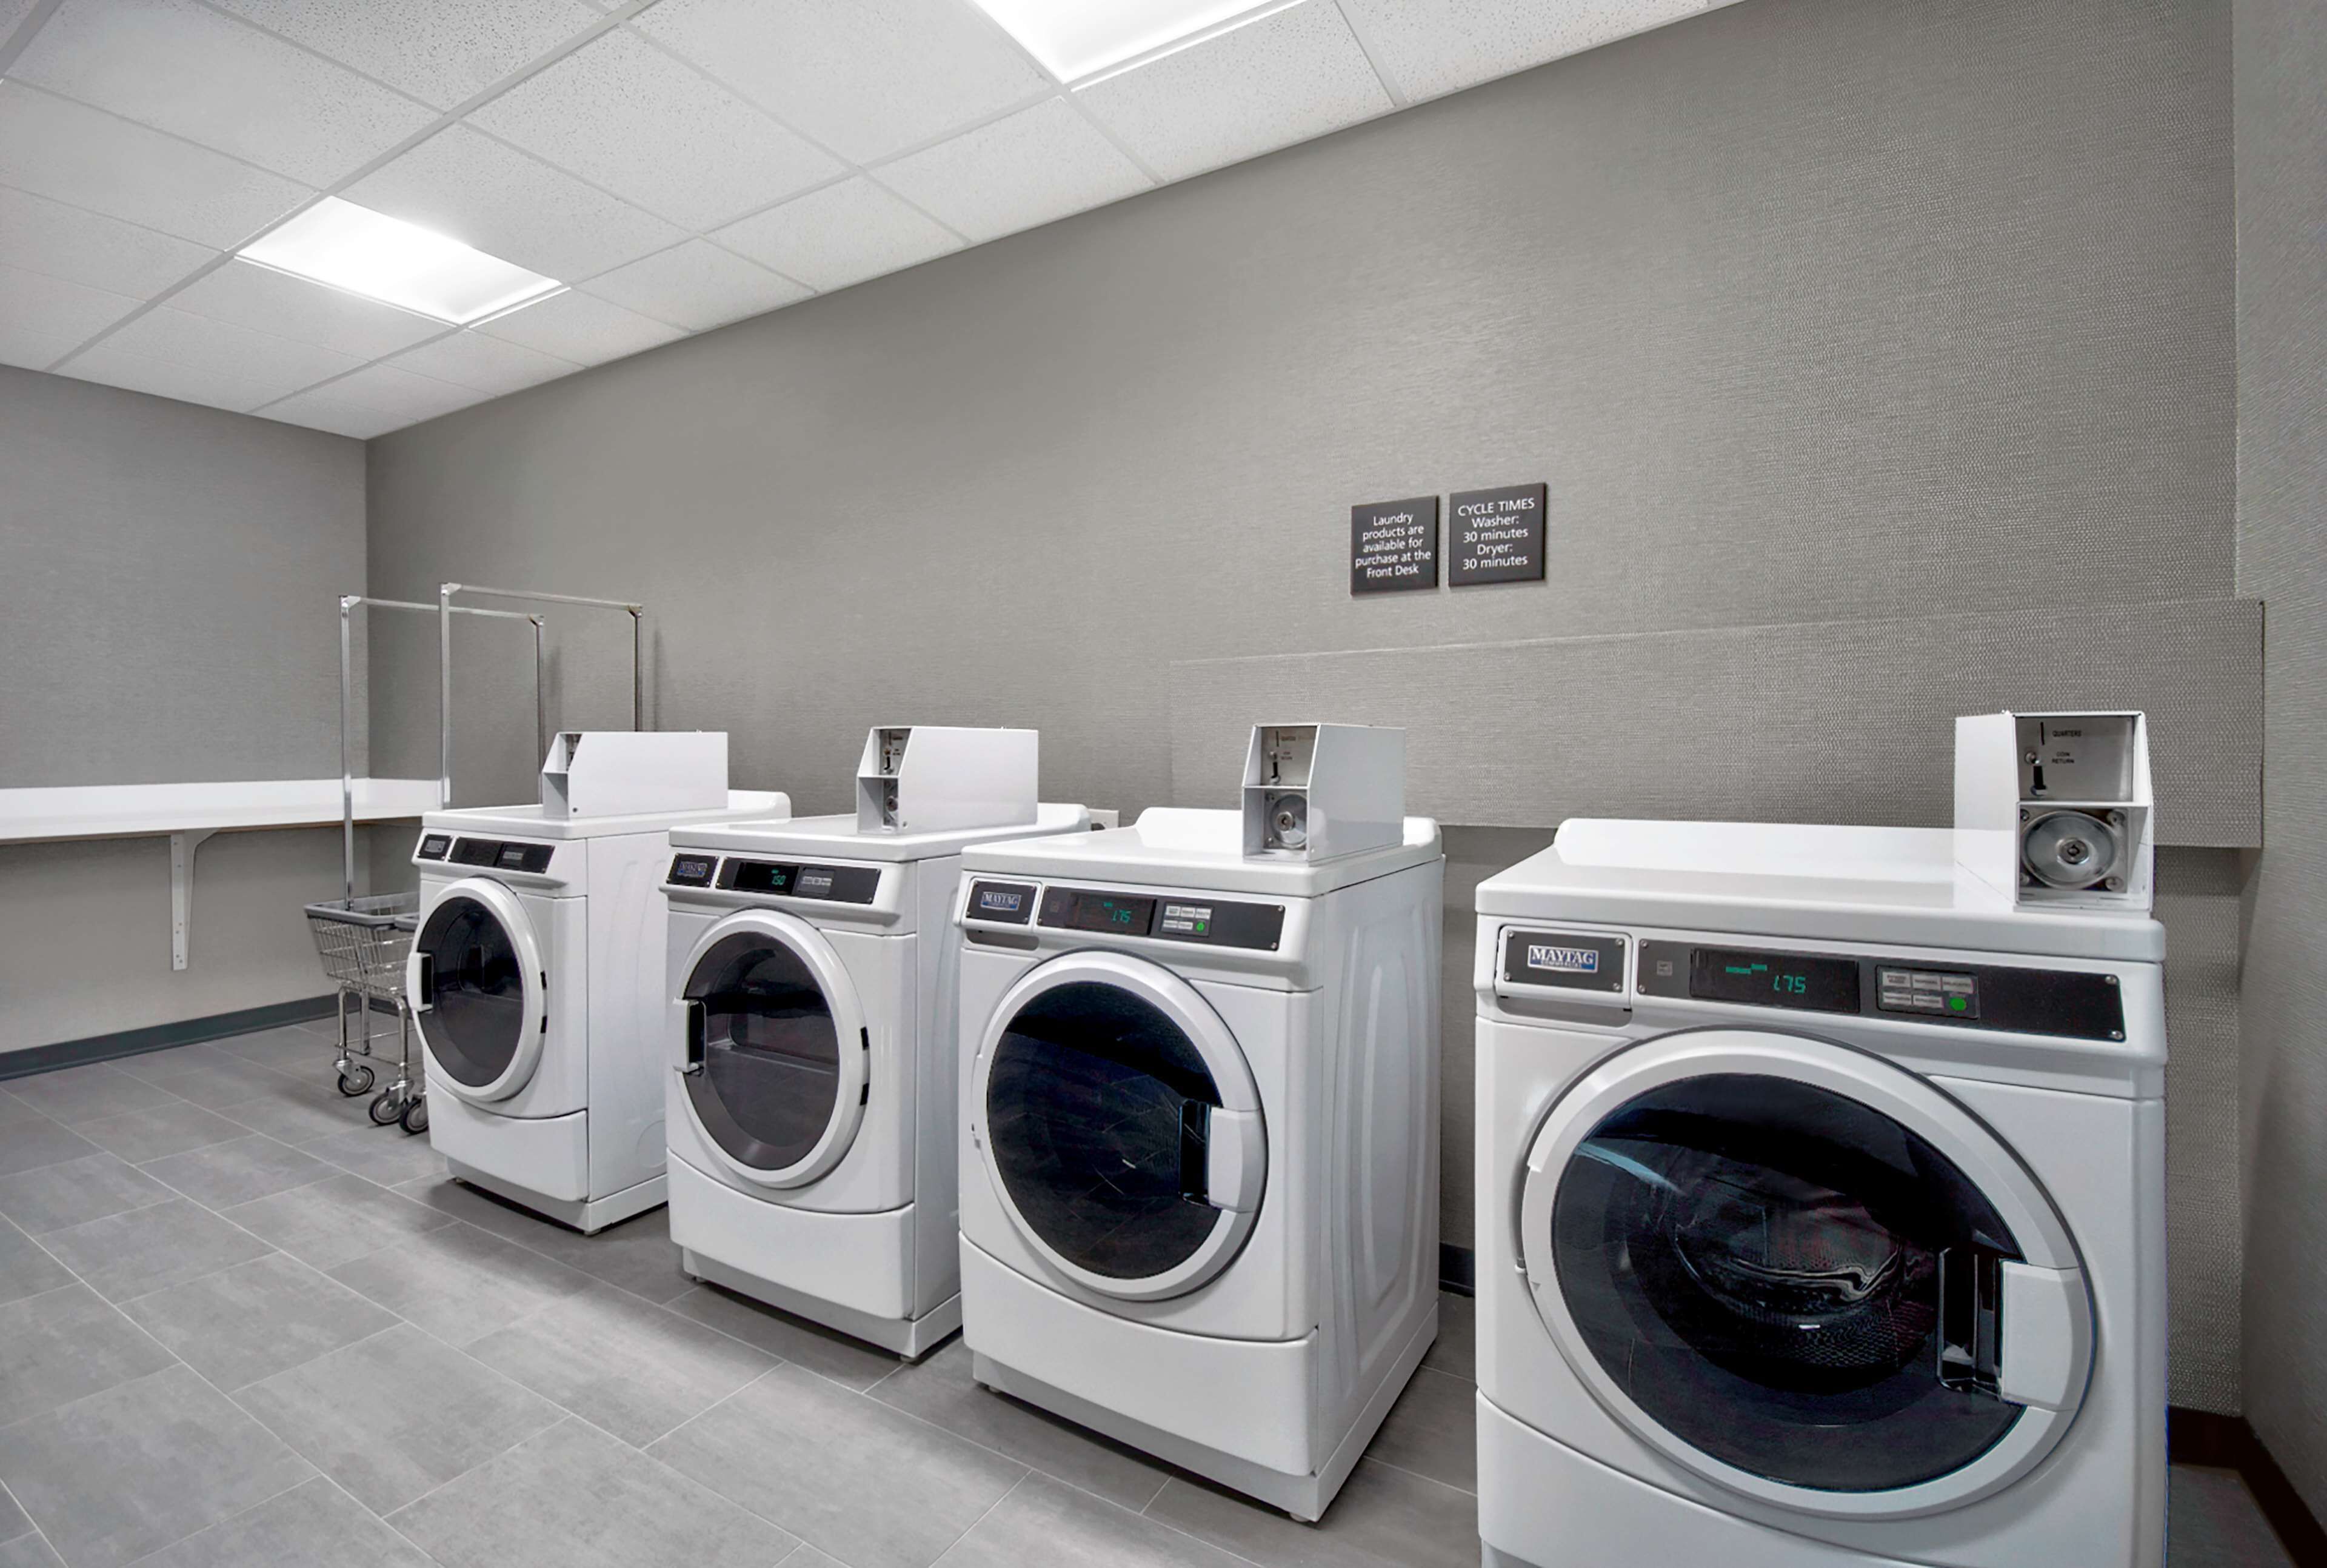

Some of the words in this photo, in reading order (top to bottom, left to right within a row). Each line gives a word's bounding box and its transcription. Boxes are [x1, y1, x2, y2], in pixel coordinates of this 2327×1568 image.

[1458, 502, 1494, 516] CYCLE
[1498, 498, 1535, 512] TIMES
[1374, 512, 1414, 526] Laundry
[1472, 515, 1519, 528] Washer:
[1363, 527, 1405, 542] products
[1408, 525, 1424, 535] are
[1463, 531, 1477, 543] 30
[1481, 529, 1528, 541] minutes
[1363, 539, 1405, 553] available
[1408, 537, 1423, 548] for
[1477, 544, 1513, 556] Dryer:
[1355, 553, 1398, 569] purchase
[1401, 552, 1411, 562] at
[1414, 549, 1431, 561] the
[1463, 558, 1477, 570] 30
[1480, 556, 1528, 568] minutes
[1367, 567, 1392, 578] Front
[1395, 563, 1418, 575] Desk
[1532, 947, 1594, 965] MAYTAG
